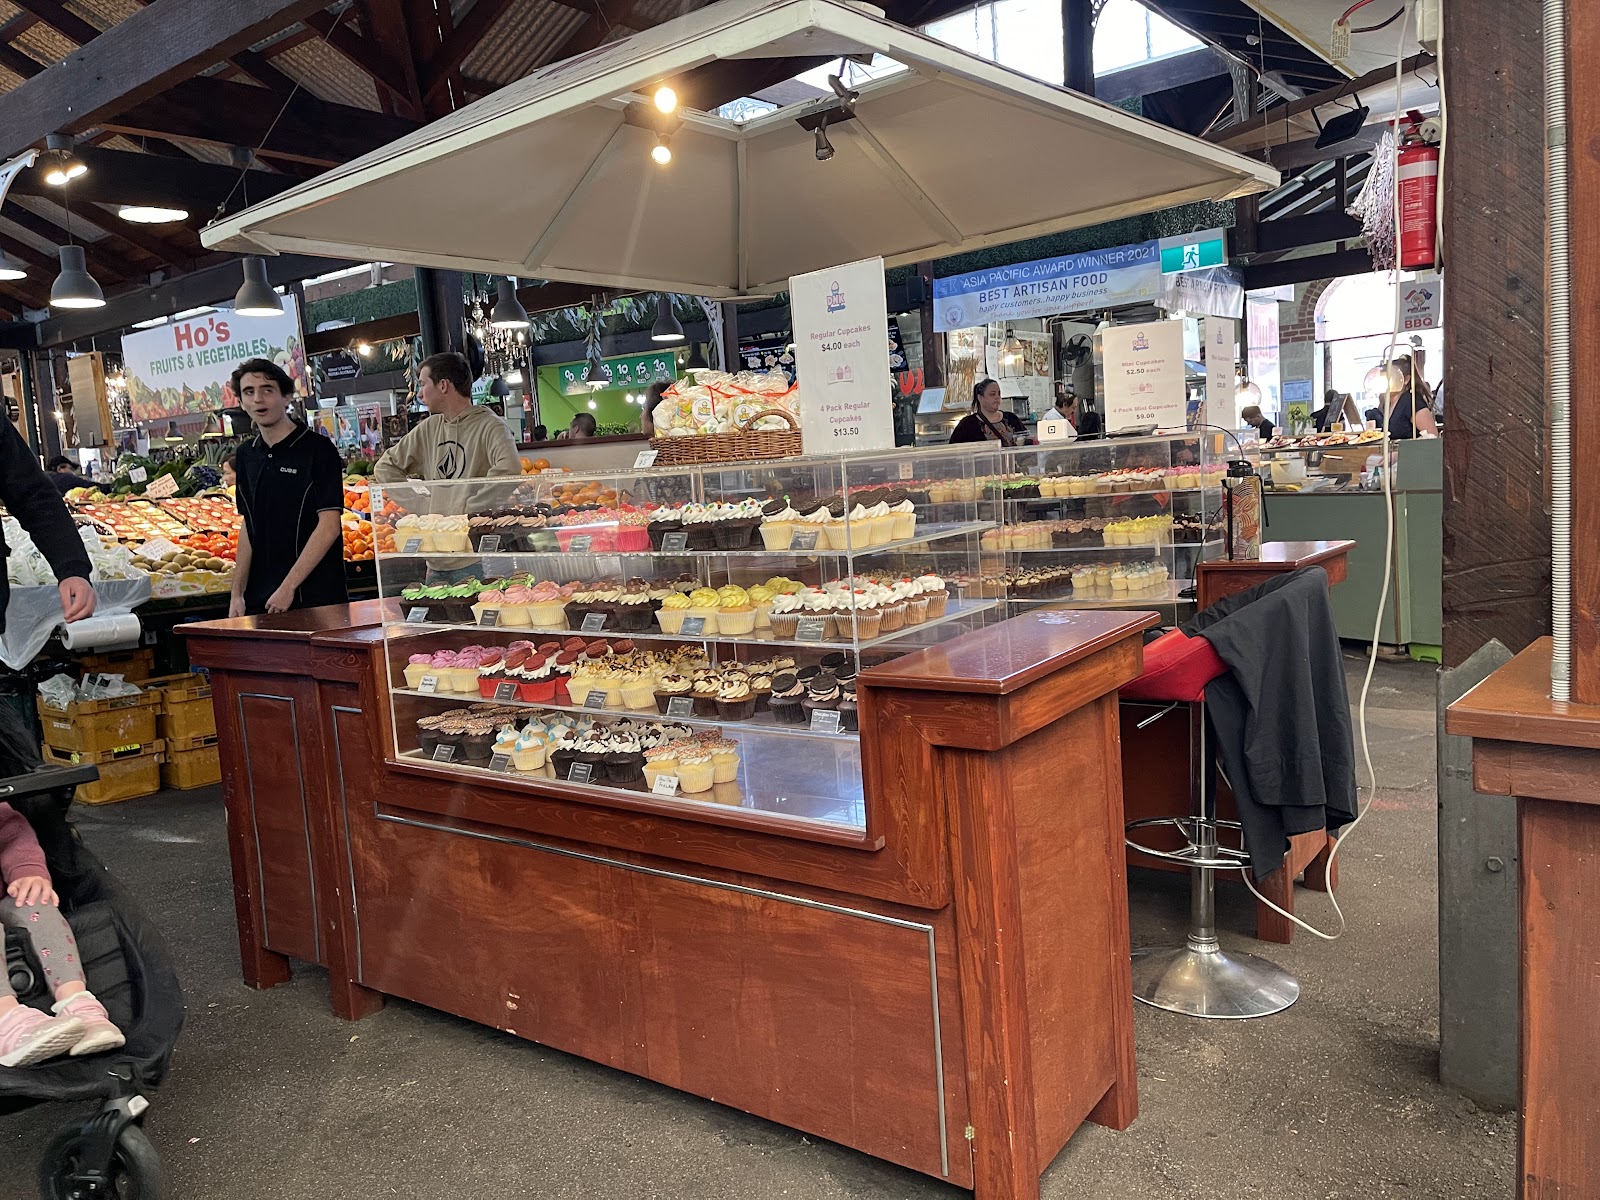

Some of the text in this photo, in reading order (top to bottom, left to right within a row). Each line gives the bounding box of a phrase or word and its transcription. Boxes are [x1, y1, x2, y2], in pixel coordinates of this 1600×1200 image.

[963, 246, 1156, 288] ASIA PACIFIC AWARD WINNER 2021
[979, 273, 1108, 303] BEST ARTISAN FOOD
[978, 303, 998, 314] happy
[1072, 286, 1108, 299] business
[989, 309, 1014, 319] Thank
[1017, 307, 1030, 316] you
[1044, 303, 1062, 313] your
[1404, 317, 1433, 329] BBQ
[174, 318, 231, 351] Ho's
[810, 325, 871, 341] Regular Cupcakes
[821, 340, 861, 352] $4.00 each
[150, 338, 268, 376] FRUITS & VEGETABLES
[1135, 358, 1165, 366] Cupcakes
[617, 363, 628, 375] 10
[635, 361, 646, 375] 15
[826, 404, 843, 412] Pack
[844, 401, 870, 411] Regular
[1148, 403, 1178, 411] Cupcakes
[829, 415, 862, 424] Cupcakes
[1136, 412, 1155, 420] $9.00
[833, 427, 859, 437] $13.50
